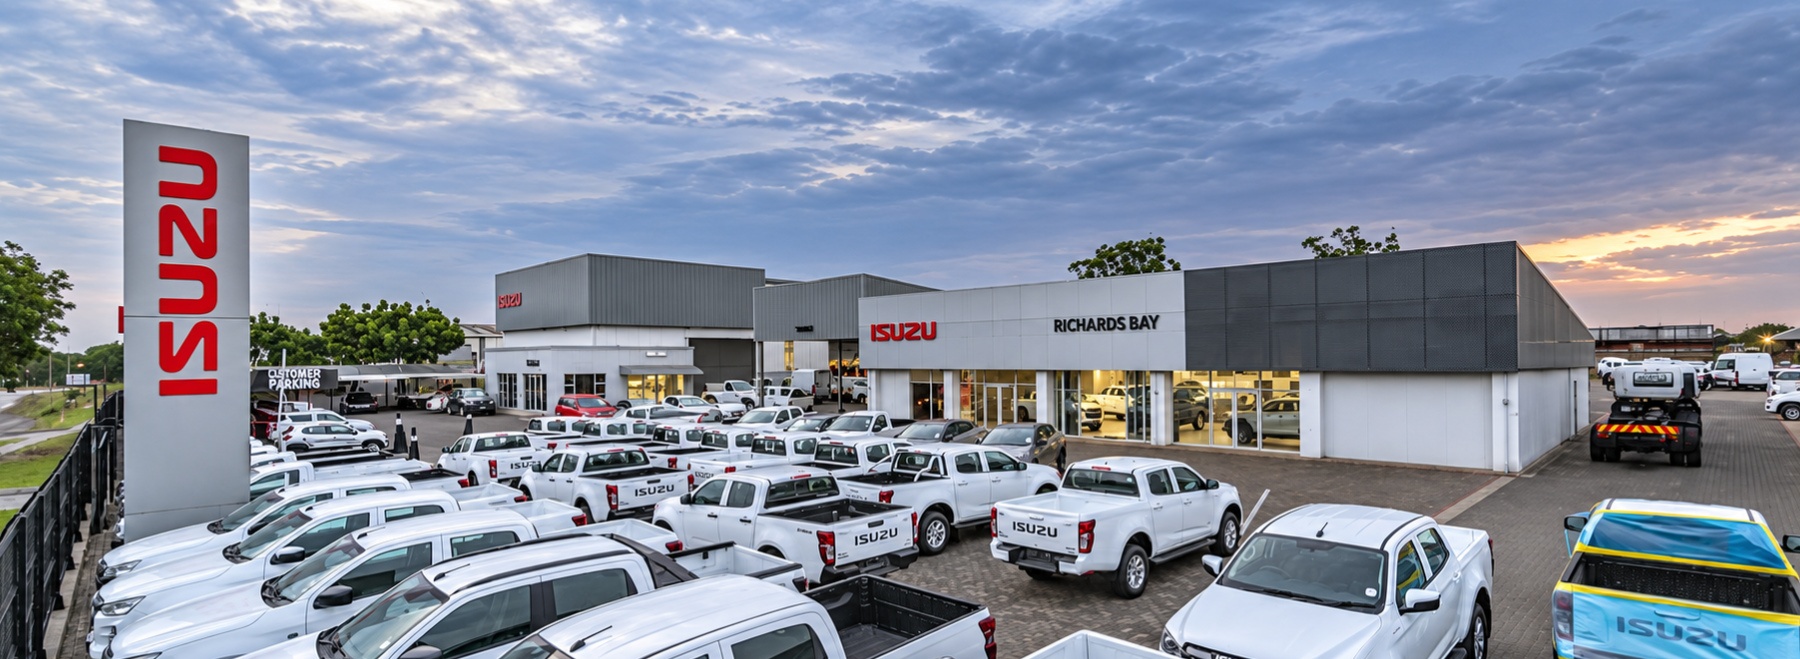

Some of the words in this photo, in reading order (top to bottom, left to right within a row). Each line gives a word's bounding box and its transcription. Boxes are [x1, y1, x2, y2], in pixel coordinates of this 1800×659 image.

[158, 145, 218, 397] ISUZU
[498, 292, 522, 309] ISUZU
[870, 321, 937, 342] ISUZU
[1053, 316, 1126, 333] RICHARDS
[1129, 315, 1160, 330] BAY
[268, 368, 321, 379] CUSTOMER
[268, 378, 320, 391] PARKING
[634, 484, 675, 497] ISUZU
[854, 527, 898, 546] ISUZU
[1012, 521, 1058, 538] ISUZU
[1616, 616, 1747, 652] ISUZU
